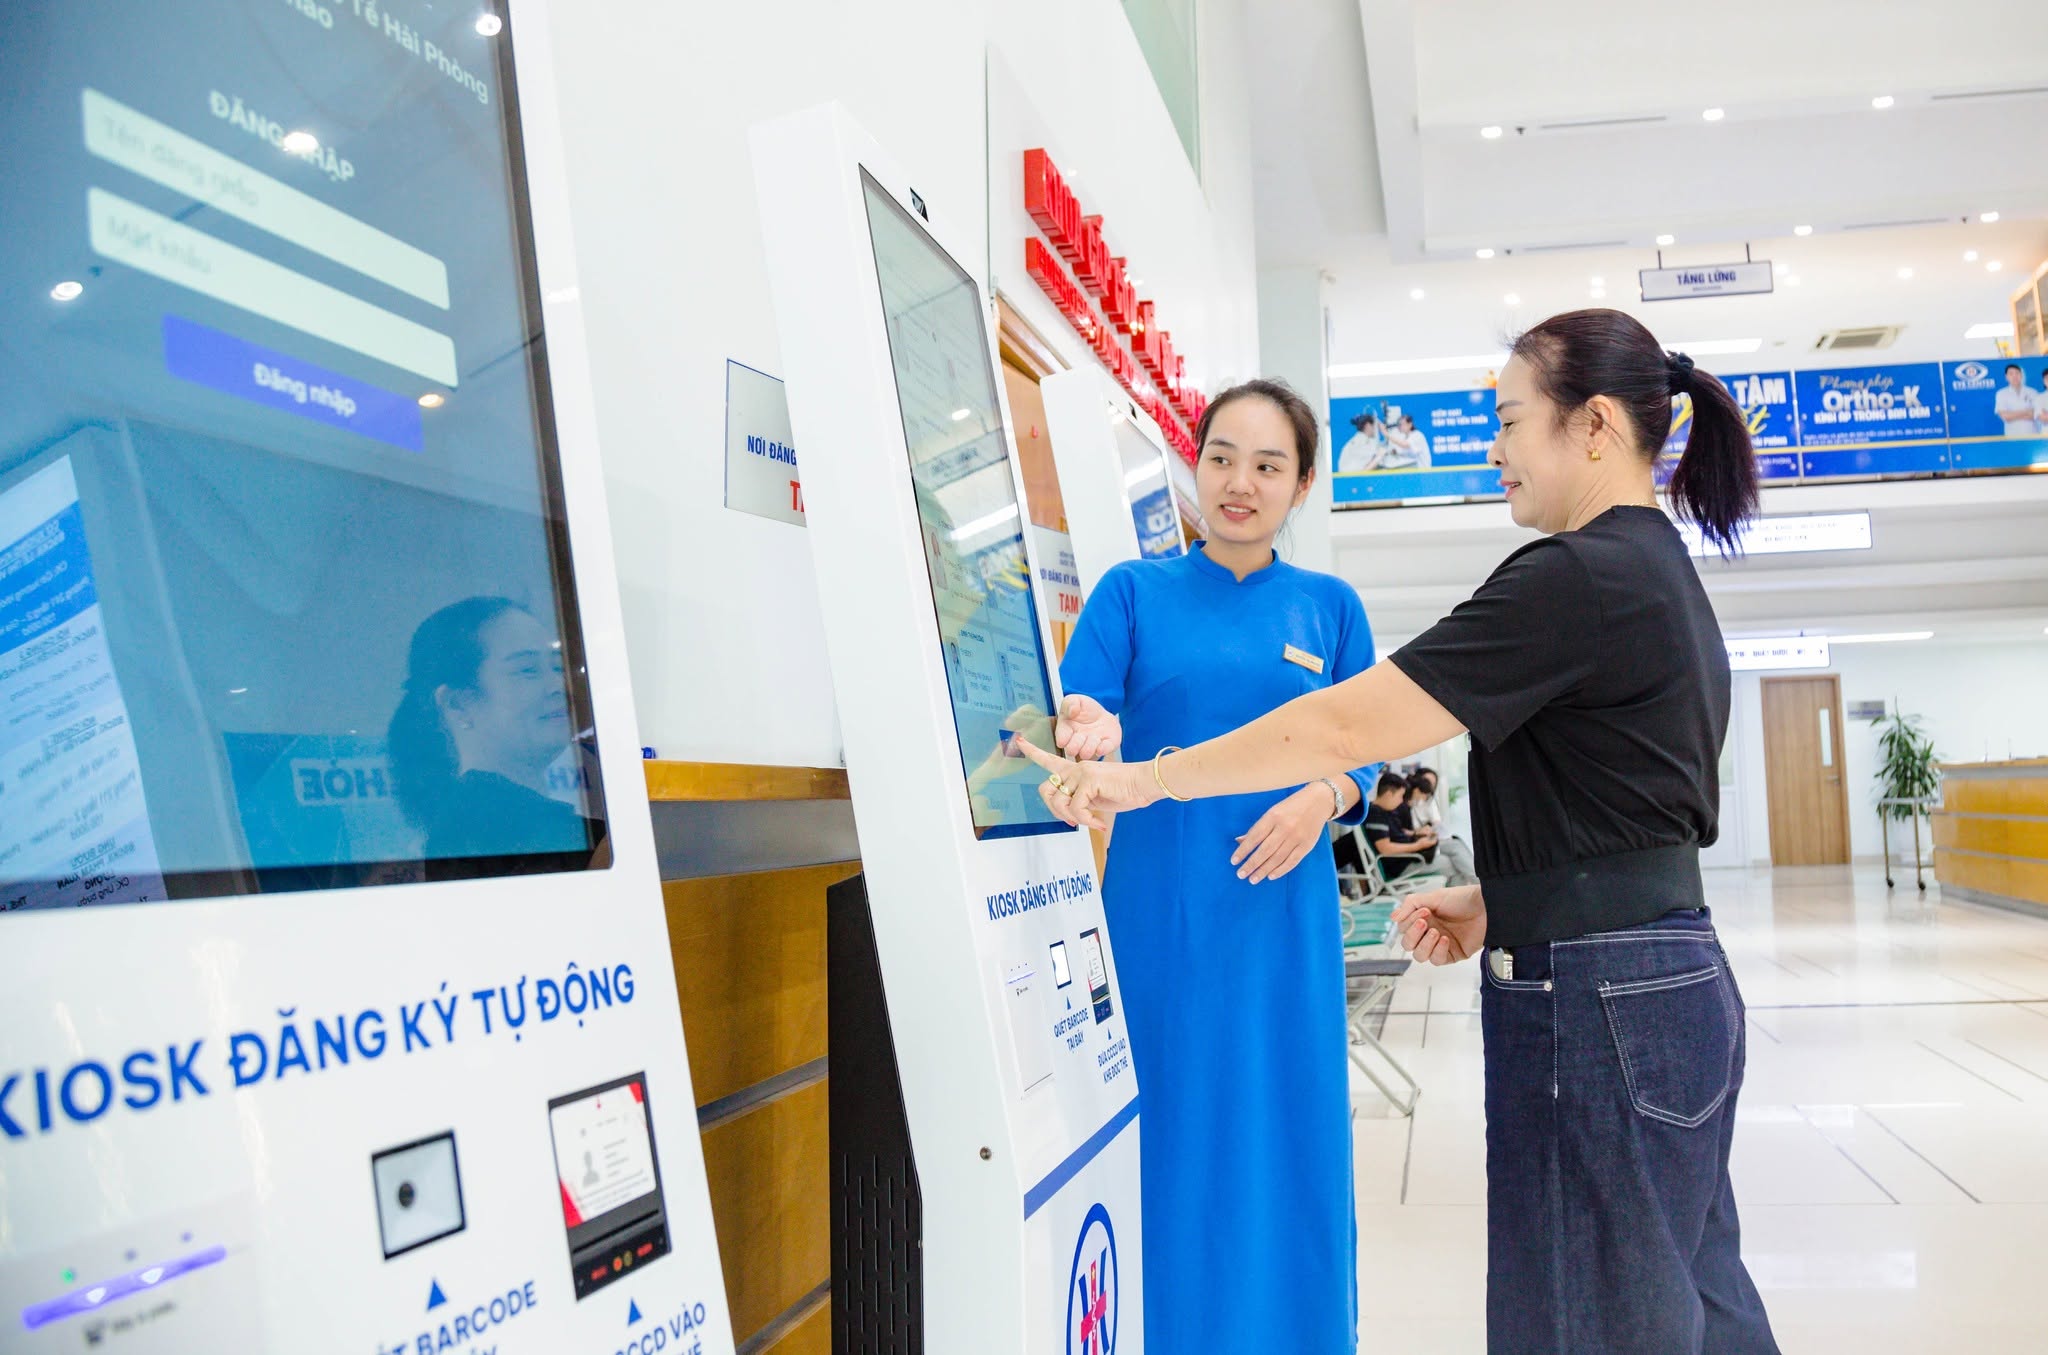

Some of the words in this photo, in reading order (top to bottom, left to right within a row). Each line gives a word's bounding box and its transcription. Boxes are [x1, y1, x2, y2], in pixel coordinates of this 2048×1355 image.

[384, 12, 420, 55] Hải
[424, 40, 489, 105] Phòng
[1823, 385, 1922, 413] Ortho-K
[986, 890, 1021, 921] KIOSK
[1020, 880, 1047, 912] ĐĂNG
[1046, 875, 1059, 904] KÝ
[1070, 870, 1093, 902] ĐỘNG
[228, 1007, 388, 1088] ĐĂNG
[400, 982, 458, 1054] KÝ
[472, 976, 528, 1041] TỰ
[536, 962, 635, 1029] ĐỘNG
[416, 1280, 538, 1355] BARCODE
[669, 1302, 706, 1341] VÀO
